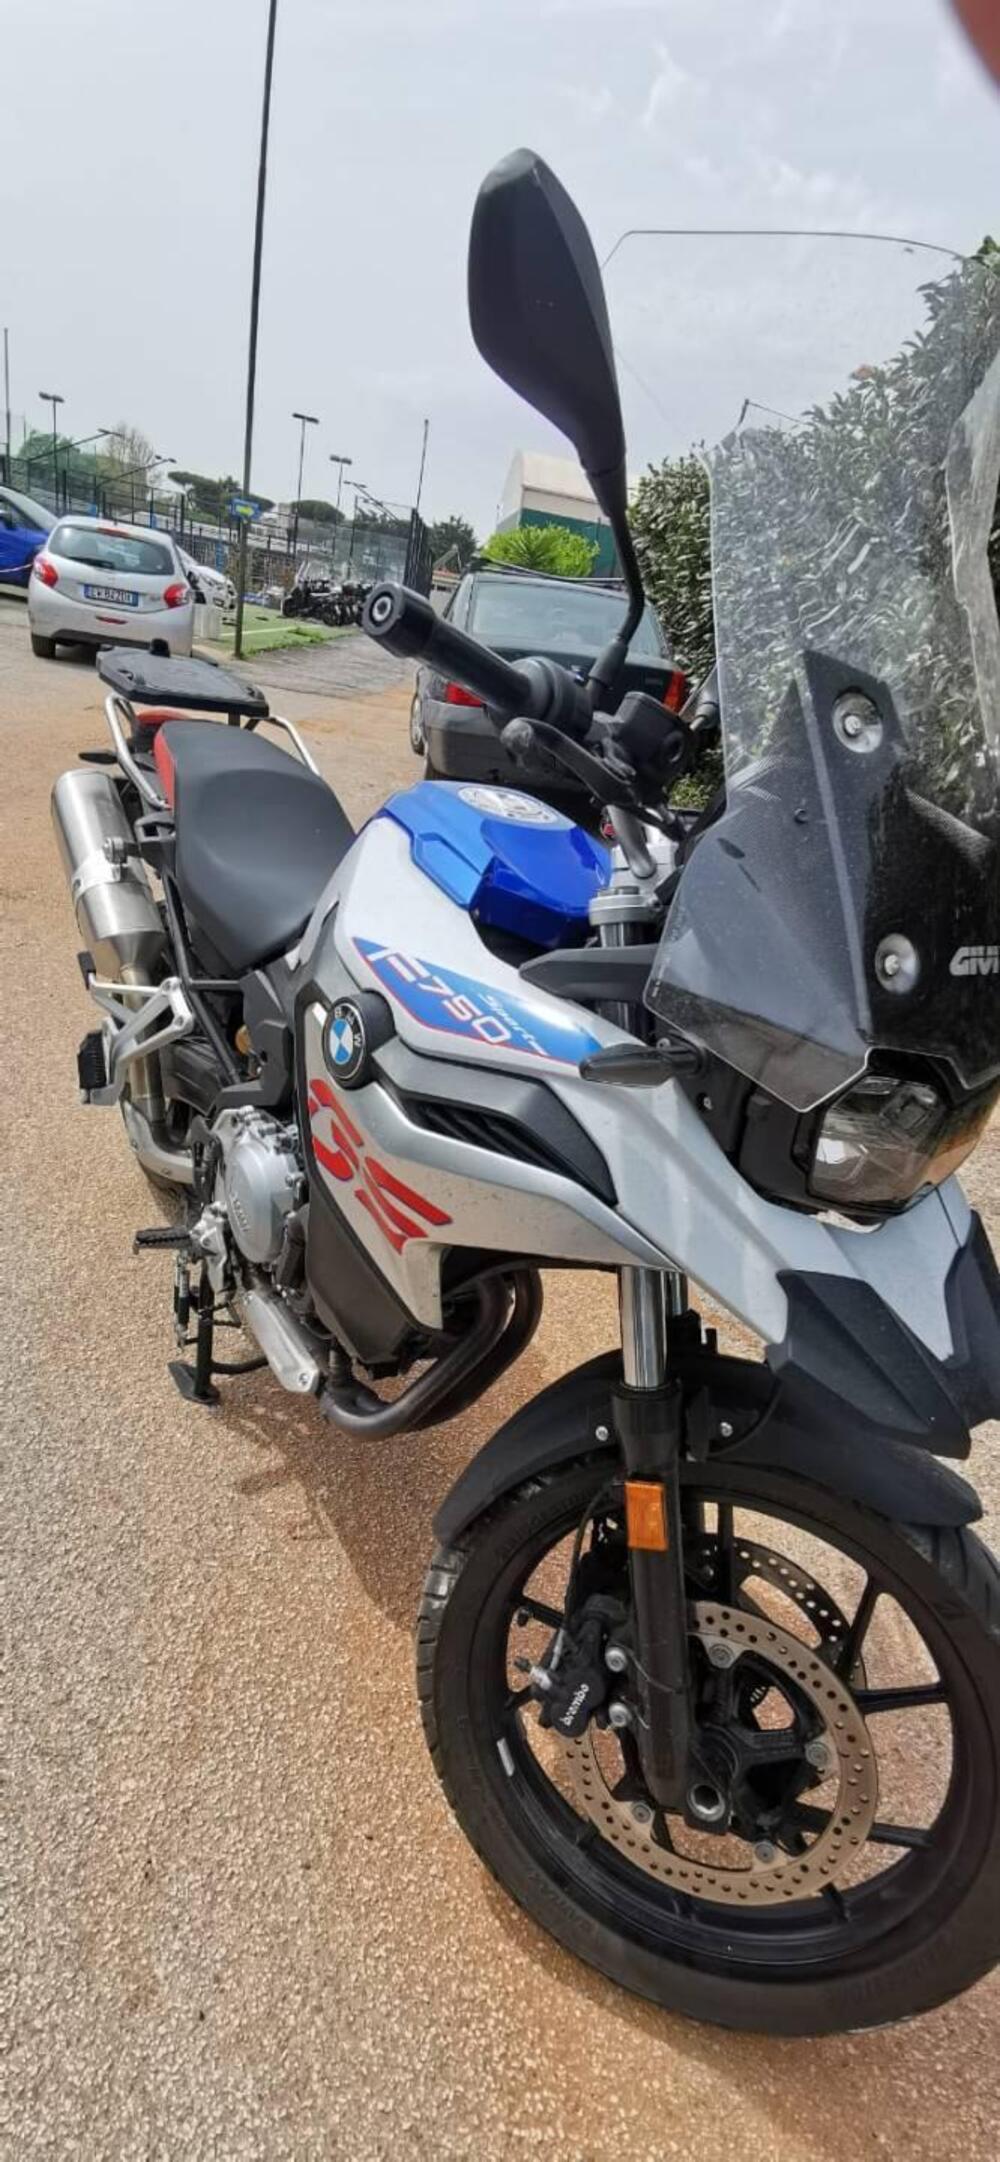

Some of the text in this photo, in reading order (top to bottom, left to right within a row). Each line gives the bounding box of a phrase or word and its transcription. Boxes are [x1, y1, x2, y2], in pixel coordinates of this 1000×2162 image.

[335, 1006, 362, 1048] BMW
[366, 952, 511, 1044] F750
[308, 1079, 453, 1255] GS
[559, 1684, 589, 1727] brembo
